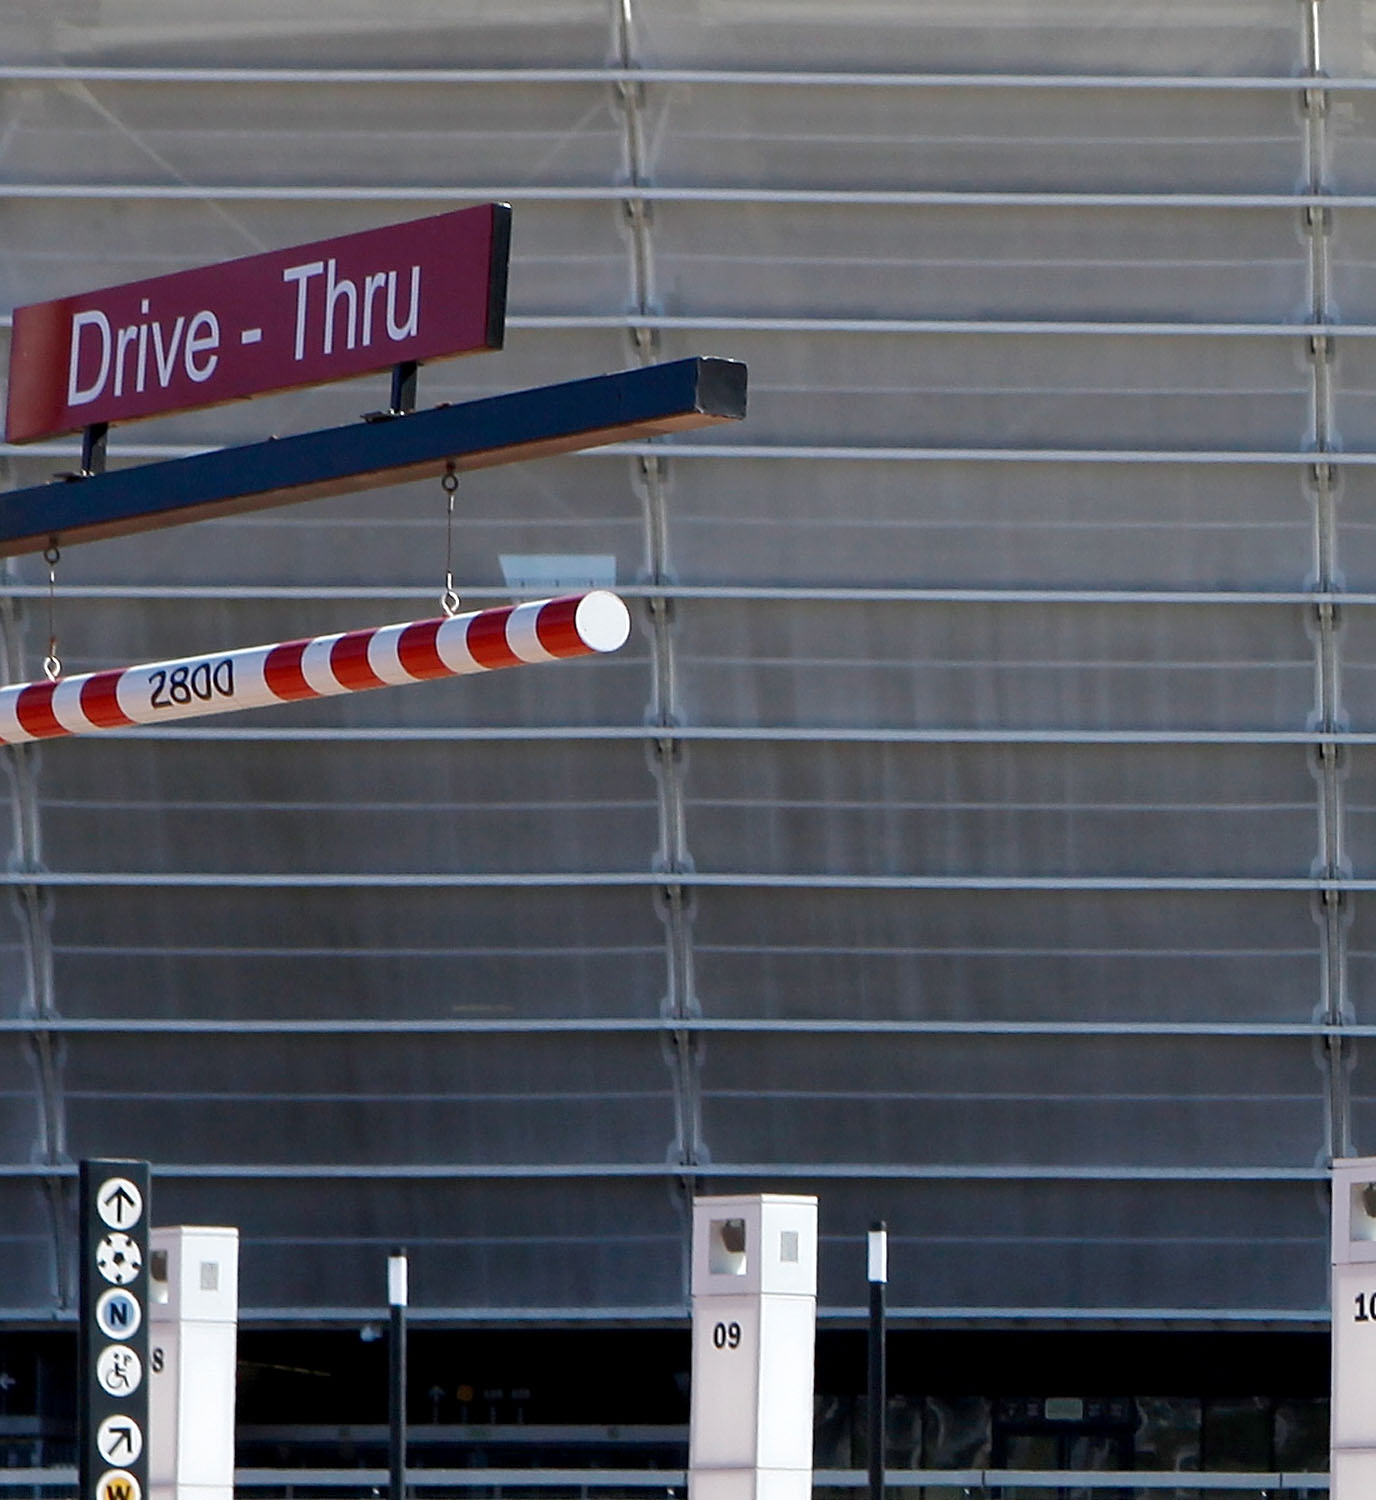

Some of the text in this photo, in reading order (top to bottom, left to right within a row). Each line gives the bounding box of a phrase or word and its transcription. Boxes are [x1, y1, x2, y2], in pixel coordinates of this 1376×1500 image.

[67, 298, 220, 408] Drive
[283, 259, 421, 361] Thru
[148, 659, 235, 709] 2800
[110, 1302, 128, 1327] N
[712, 1322, 742, 1350] 09
[151, 1347, 165, 1374] 8
